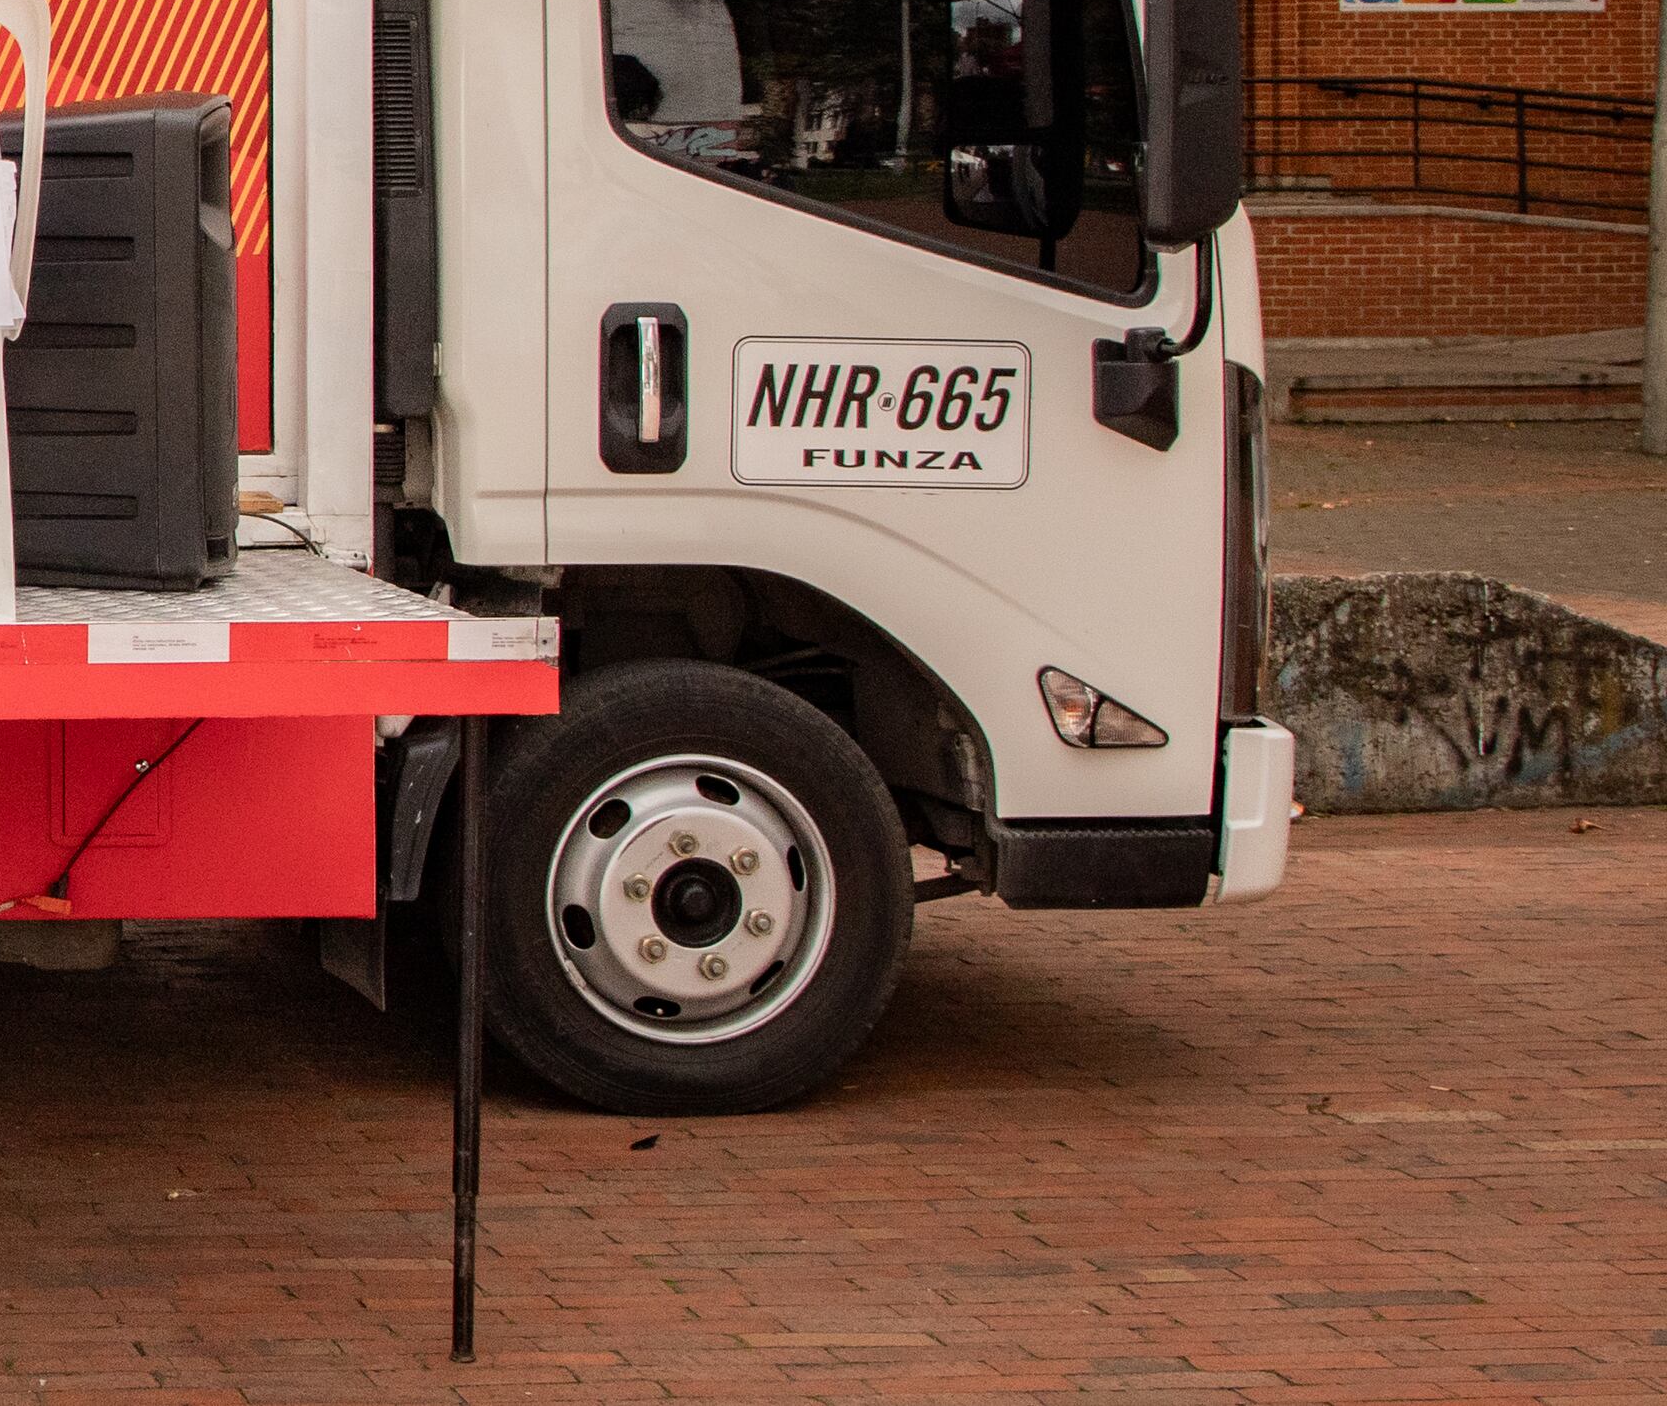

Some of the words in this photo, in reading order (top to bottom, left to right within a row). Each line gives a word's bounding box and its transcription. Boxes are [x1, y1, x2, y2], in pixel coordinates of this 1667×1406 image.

[746, 362, 880, 428] NHR
[896, 364, 1018, 432] 665
[802, 447, 984, 471] FUNZA
